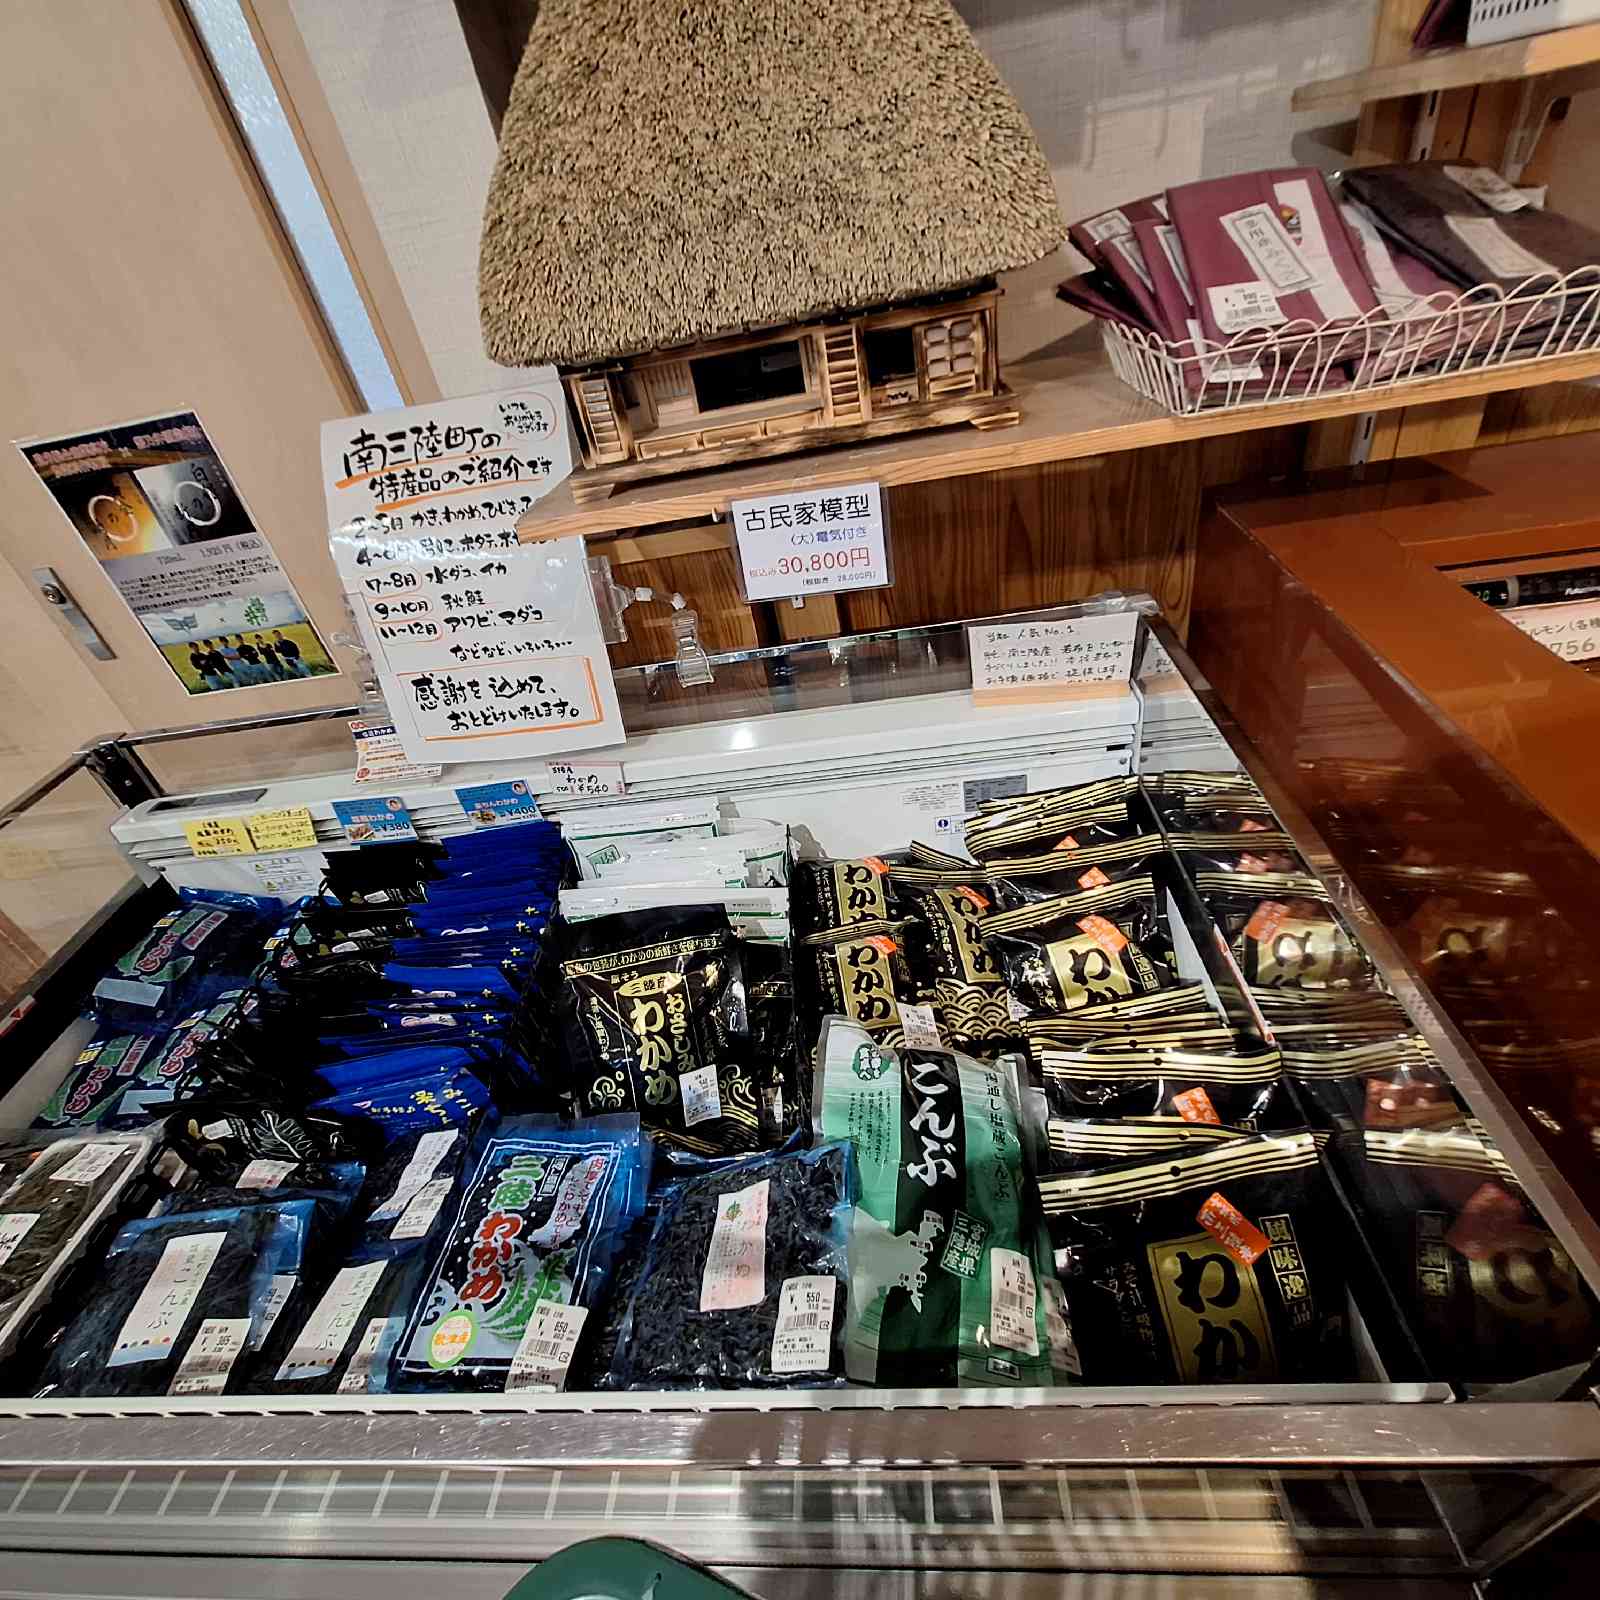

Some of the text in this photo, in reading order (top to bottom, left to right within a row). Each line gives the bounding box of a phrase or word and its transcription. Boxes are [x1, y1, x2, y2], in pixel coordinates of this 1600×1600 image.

[498, 401, 528, 413] いつも
[343, 420, 502, 479] 南三陸町の
[369, 453, 552, 504] 特産品のご紹介です
[742, 493, 871, 532] 古民家模型
[425, 561, 508, 585] 水ダコ、イカ
[440, 590, 486, 610] 秋鮭
[443, 604, 543, 633] アワビ、マダコ
[411, 673, 557, 712] 感謝を込めて、
[447, 699, 580, 731] おとどけいたします。
[847, 945, 891, 1022] わかめ
[630, 998, 678, 1106] わかめ
[906, 1062, 958, 1187] こんぶ
[959, 1222, 985, 1276] 宮城県
